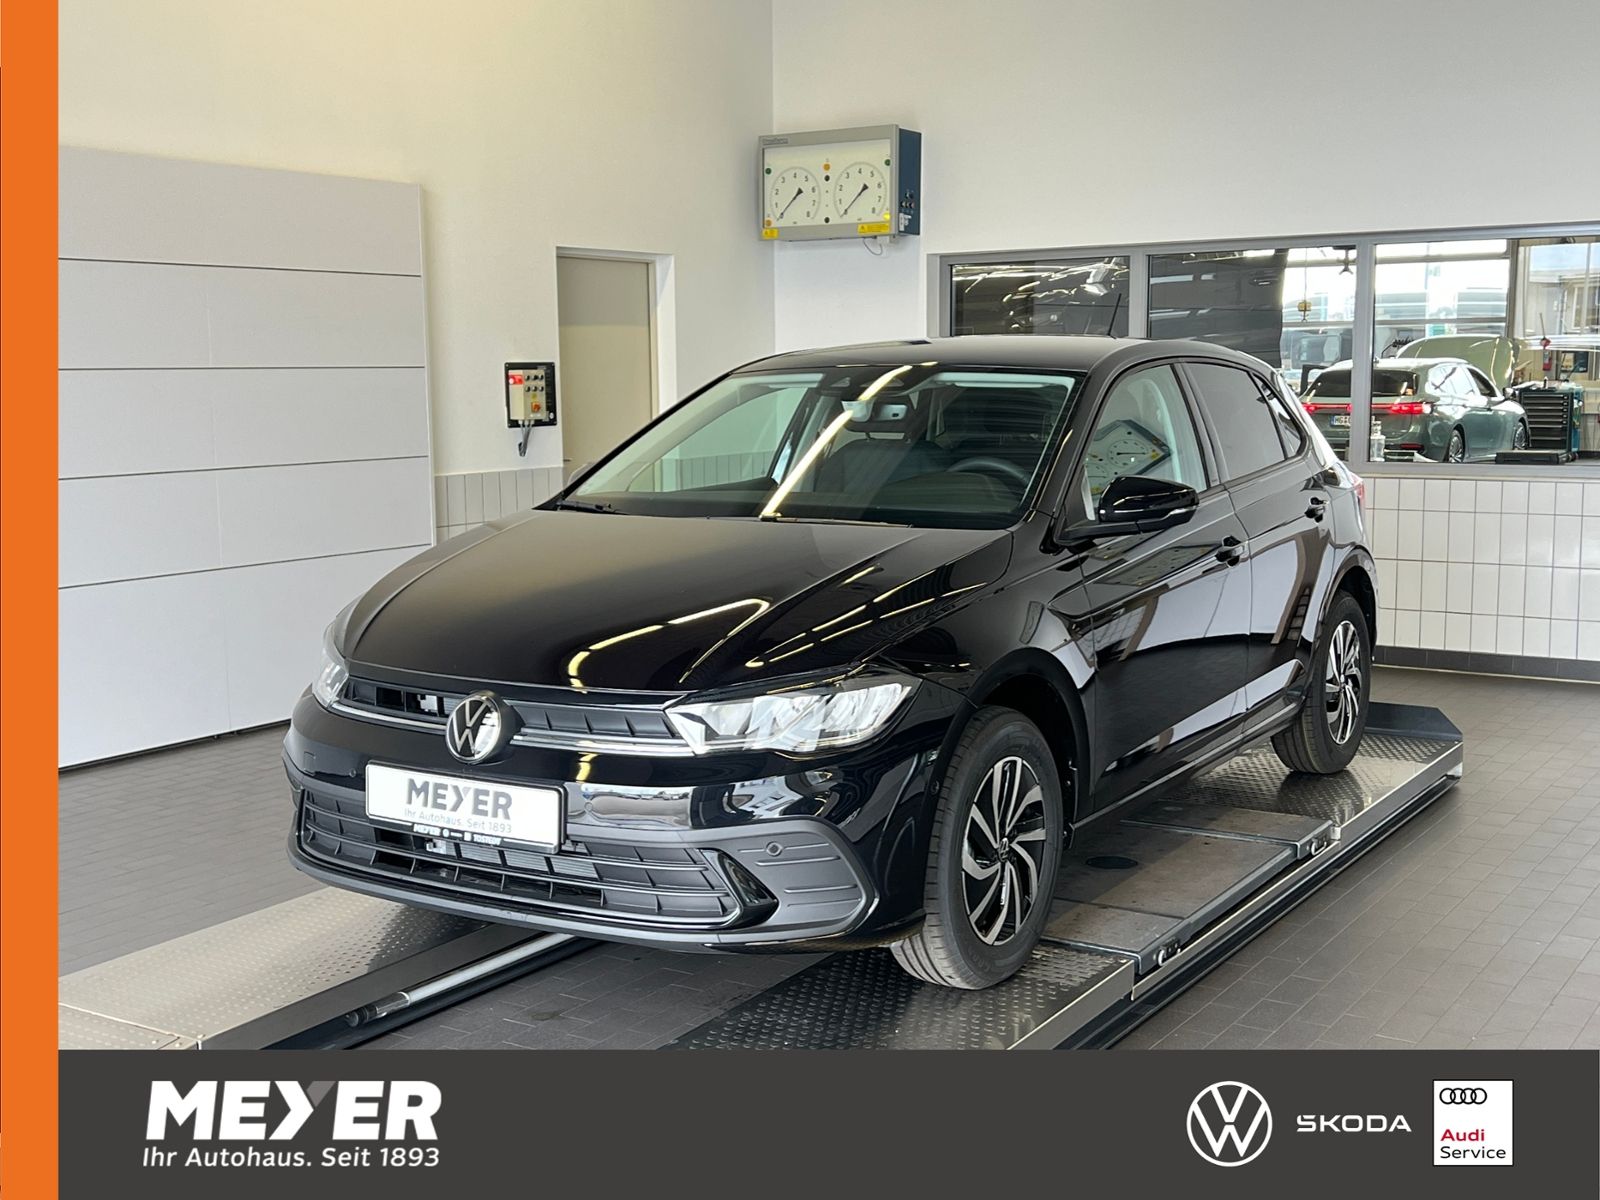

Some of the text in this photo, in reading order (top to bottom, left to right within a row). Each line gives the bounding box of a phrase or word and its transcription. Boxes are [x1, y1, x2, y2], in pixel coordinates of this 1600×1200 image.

[406, 778, 512, 821] MEYER
[404, 808, 417, 818] Ihr
[467, 818, 486, 831] Seit
[488, 820, 512, 834] 1893
